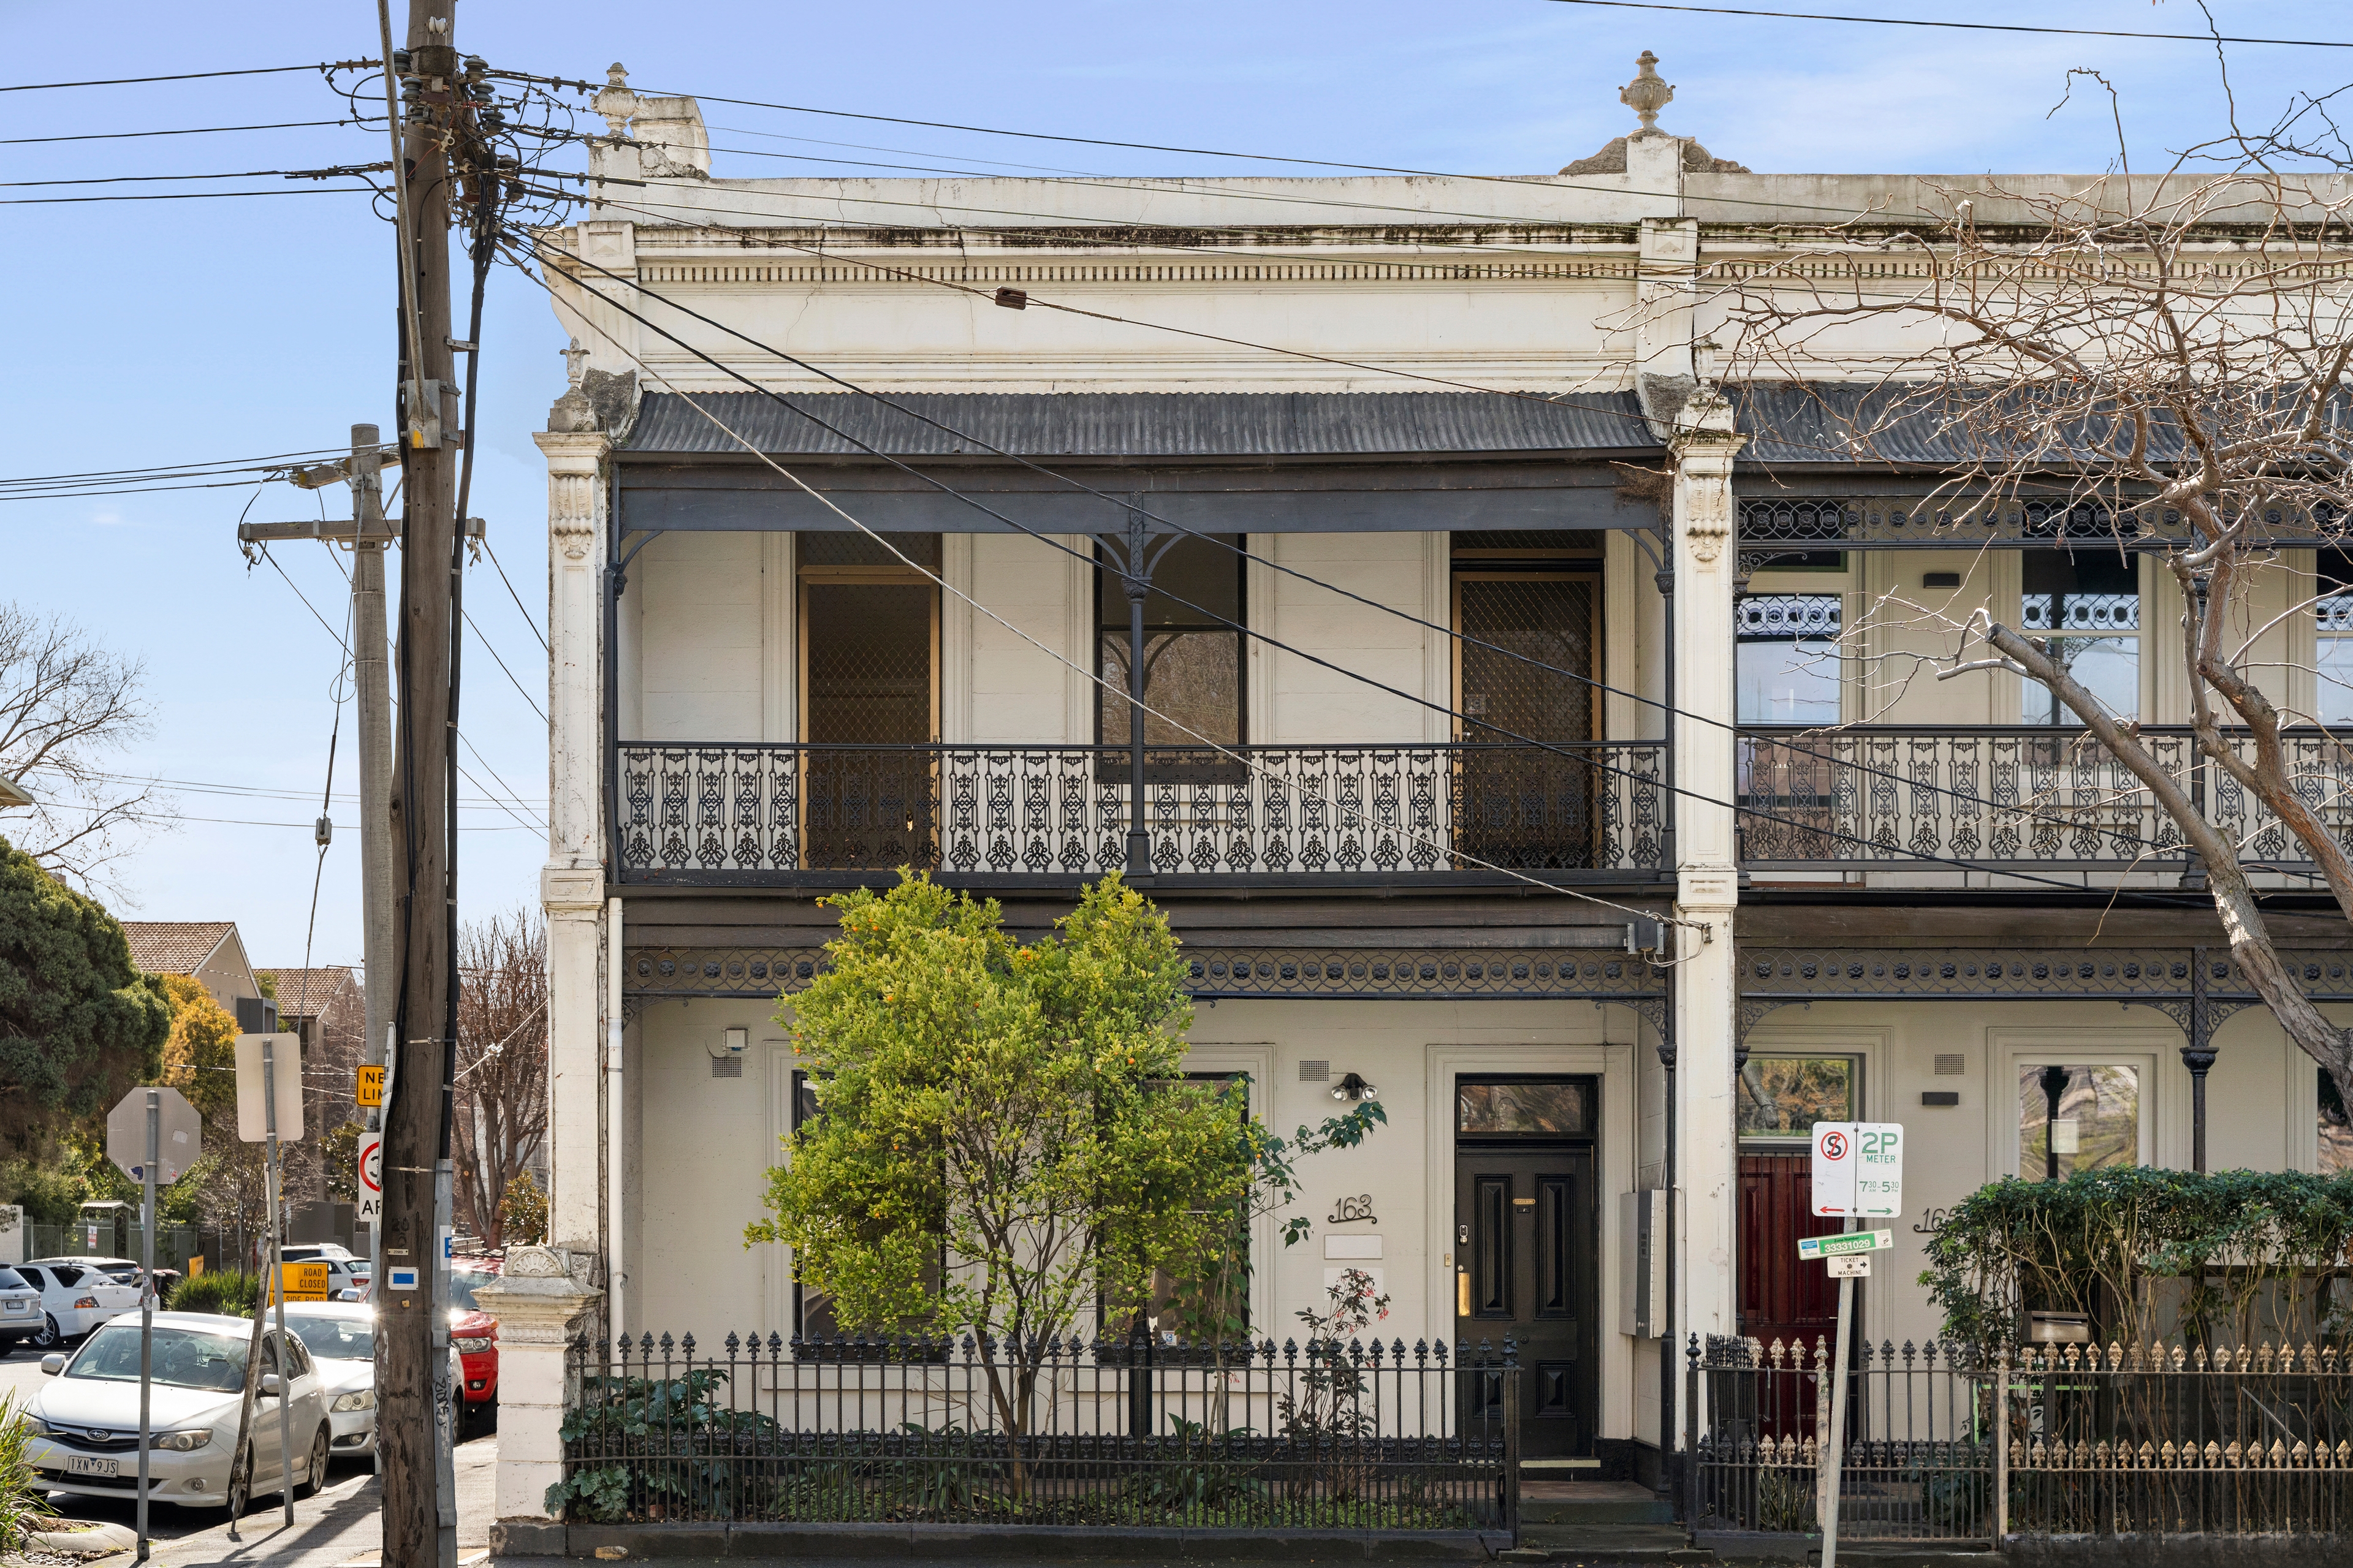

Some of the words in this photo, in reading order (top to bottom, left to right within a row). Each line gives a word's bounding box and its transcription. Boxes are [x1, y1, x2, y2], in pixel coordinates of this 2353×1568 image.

[366, 1072, 384, 1084] NE
[1861, 1132, 1898, 1154] 2P
[370, 1156, 379, 1178] 3
[1336, 1194, 1372, 1221] 163
[1825, 1239, 1871, 1252] 33331029
[303, 1268, 322, 1276] ROAD
[300, 1279, 325, 1288] CLOSED
[72, 1459, 89, 1471] 1XN
[97, 1461, 116, 1473] 9JS
